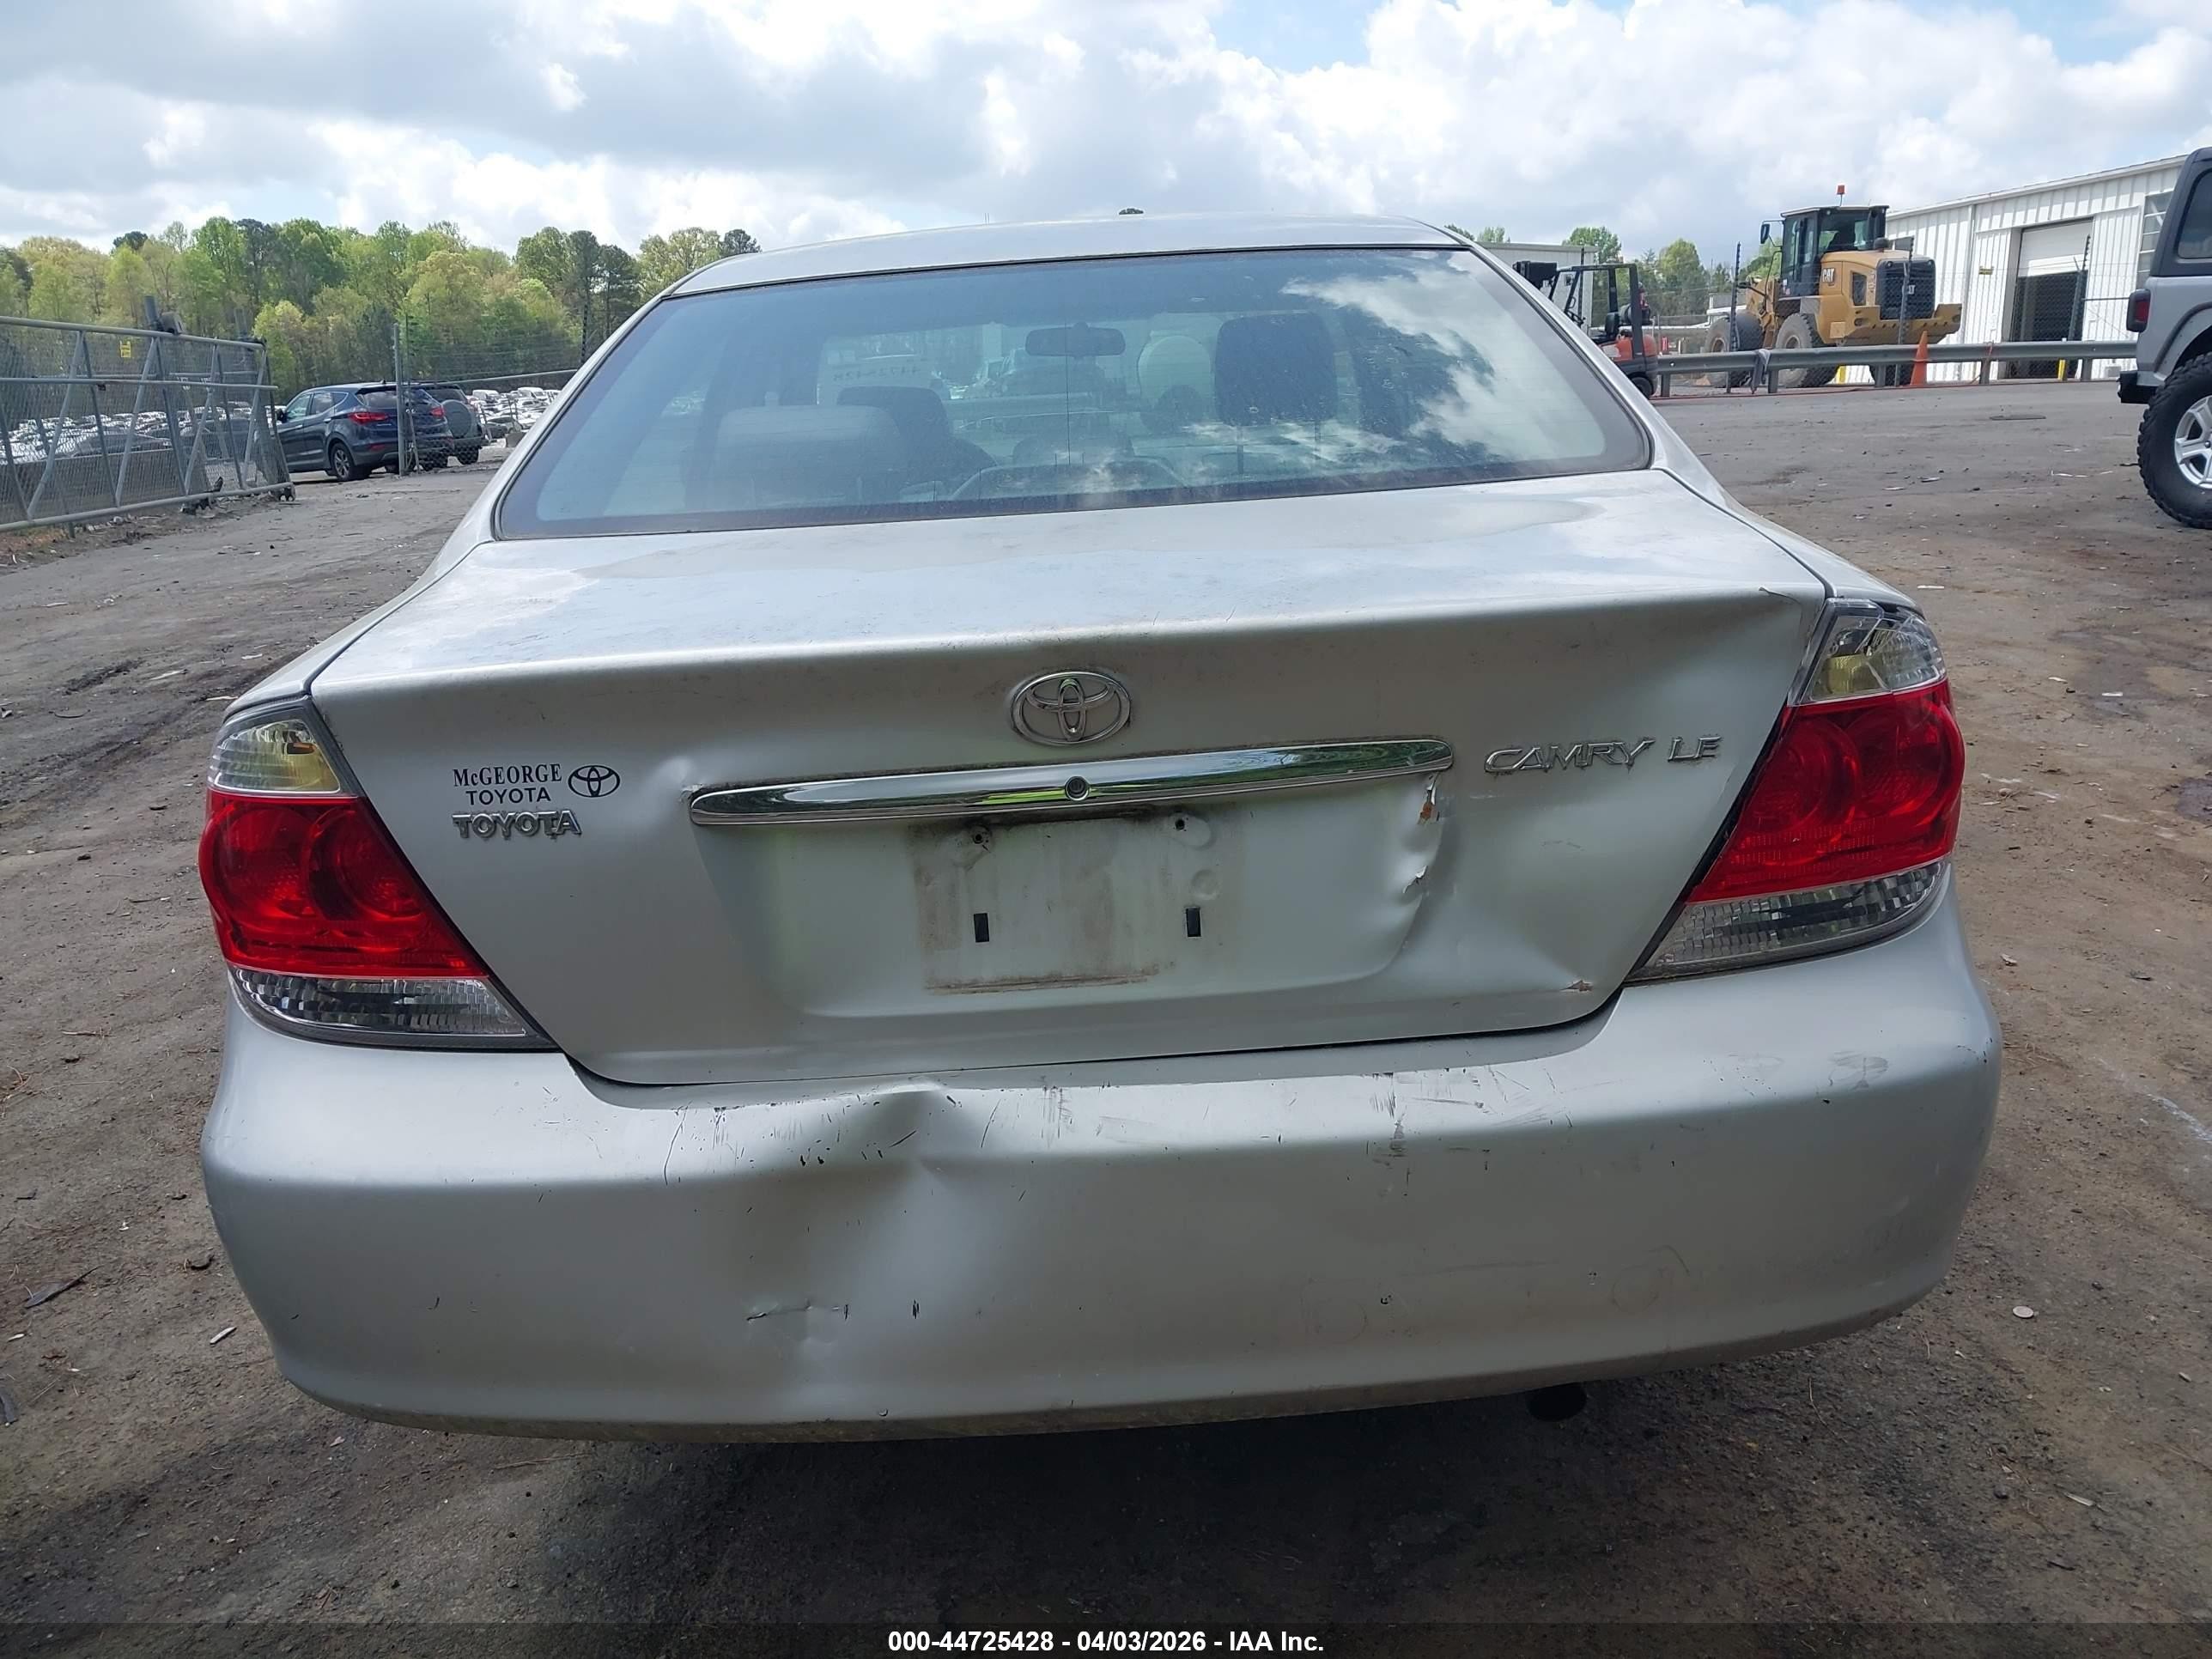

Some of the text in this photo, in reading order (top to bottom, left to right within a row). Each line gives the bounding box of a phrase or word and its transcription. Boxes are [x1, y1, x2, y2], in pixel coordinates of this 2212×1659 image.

[1822, 268, 1835, 283] CAT
[1485, 736, 1722, 773] CAMRY LE
[453, 763, 562, 787] McGEORGE
[465, 787, 551, 805] TOYOTA
[452, 809, 582, 839] TOYOTA
